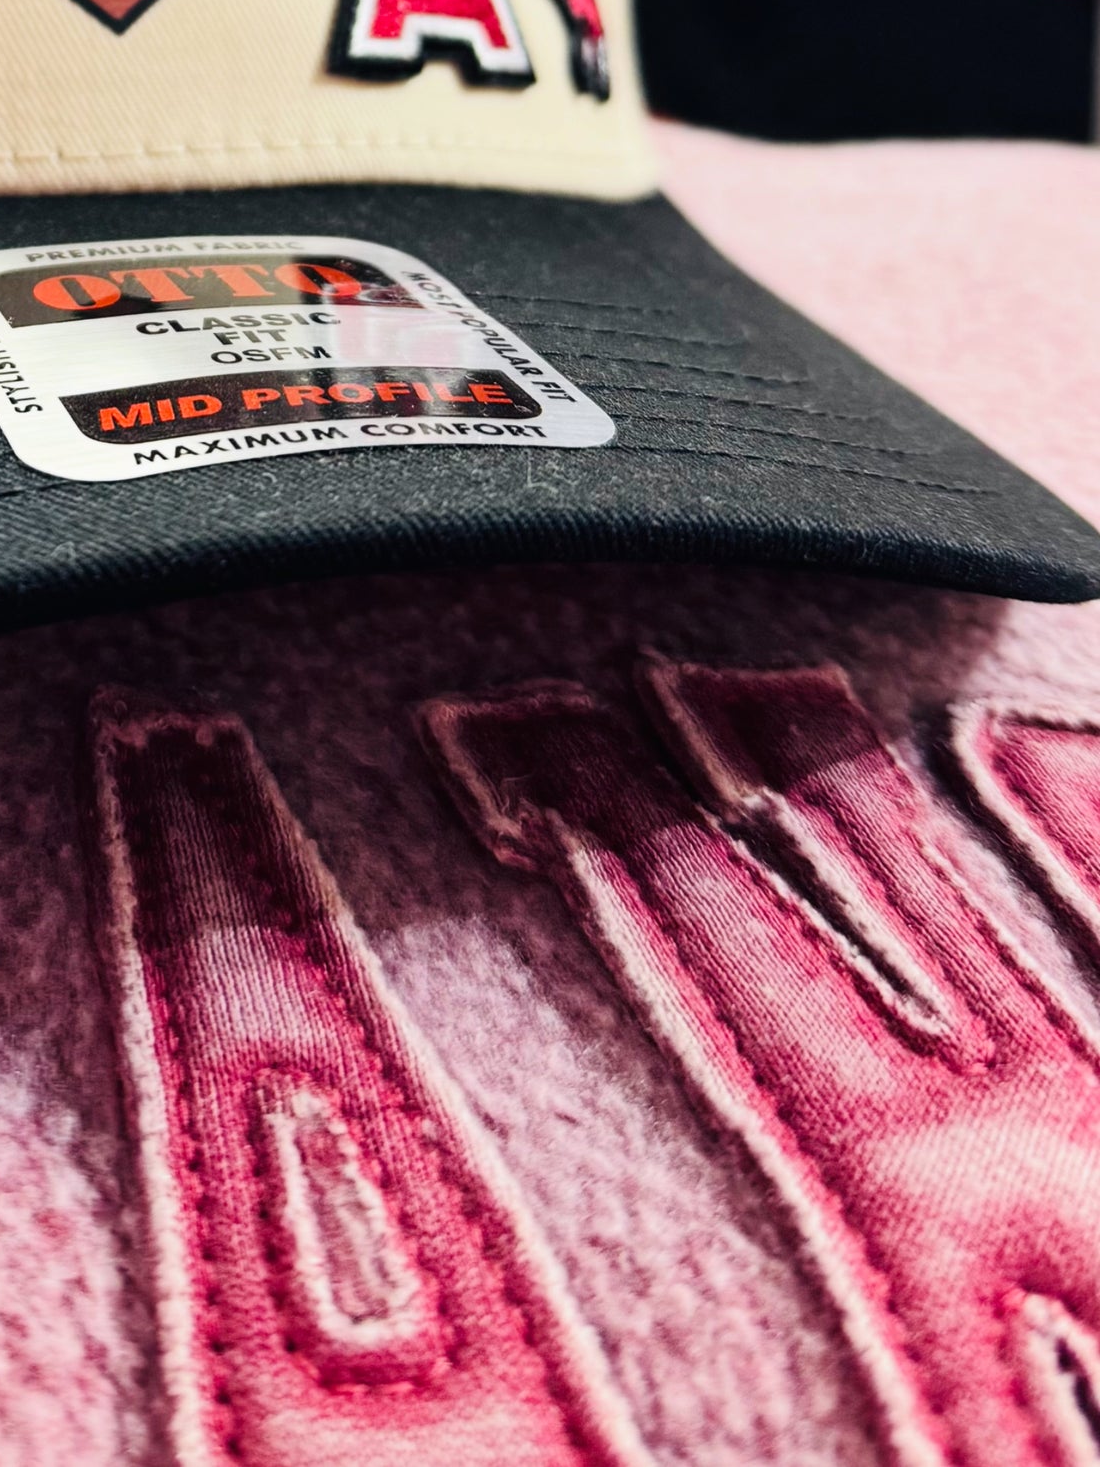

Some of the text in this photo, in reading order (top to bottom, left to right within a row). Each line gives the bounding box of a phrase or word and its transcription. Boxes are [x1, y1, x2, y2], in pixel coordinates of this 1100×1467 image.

[24, 240, 304, 263] PREMIUM FABRIC
[32, 263, 362, 311] OTTO
[136, 312, 338, 335] CLASSIC
[213, 329, 287, 345] FIT
[402, 270, 578, 403] MOST POPULAR FIT
[211, 345, 332, 364] OSFM
[99, 382, 513, 432] MID PROFILE
[133, 422, 548, 465] MAXIMUM COMFORT
